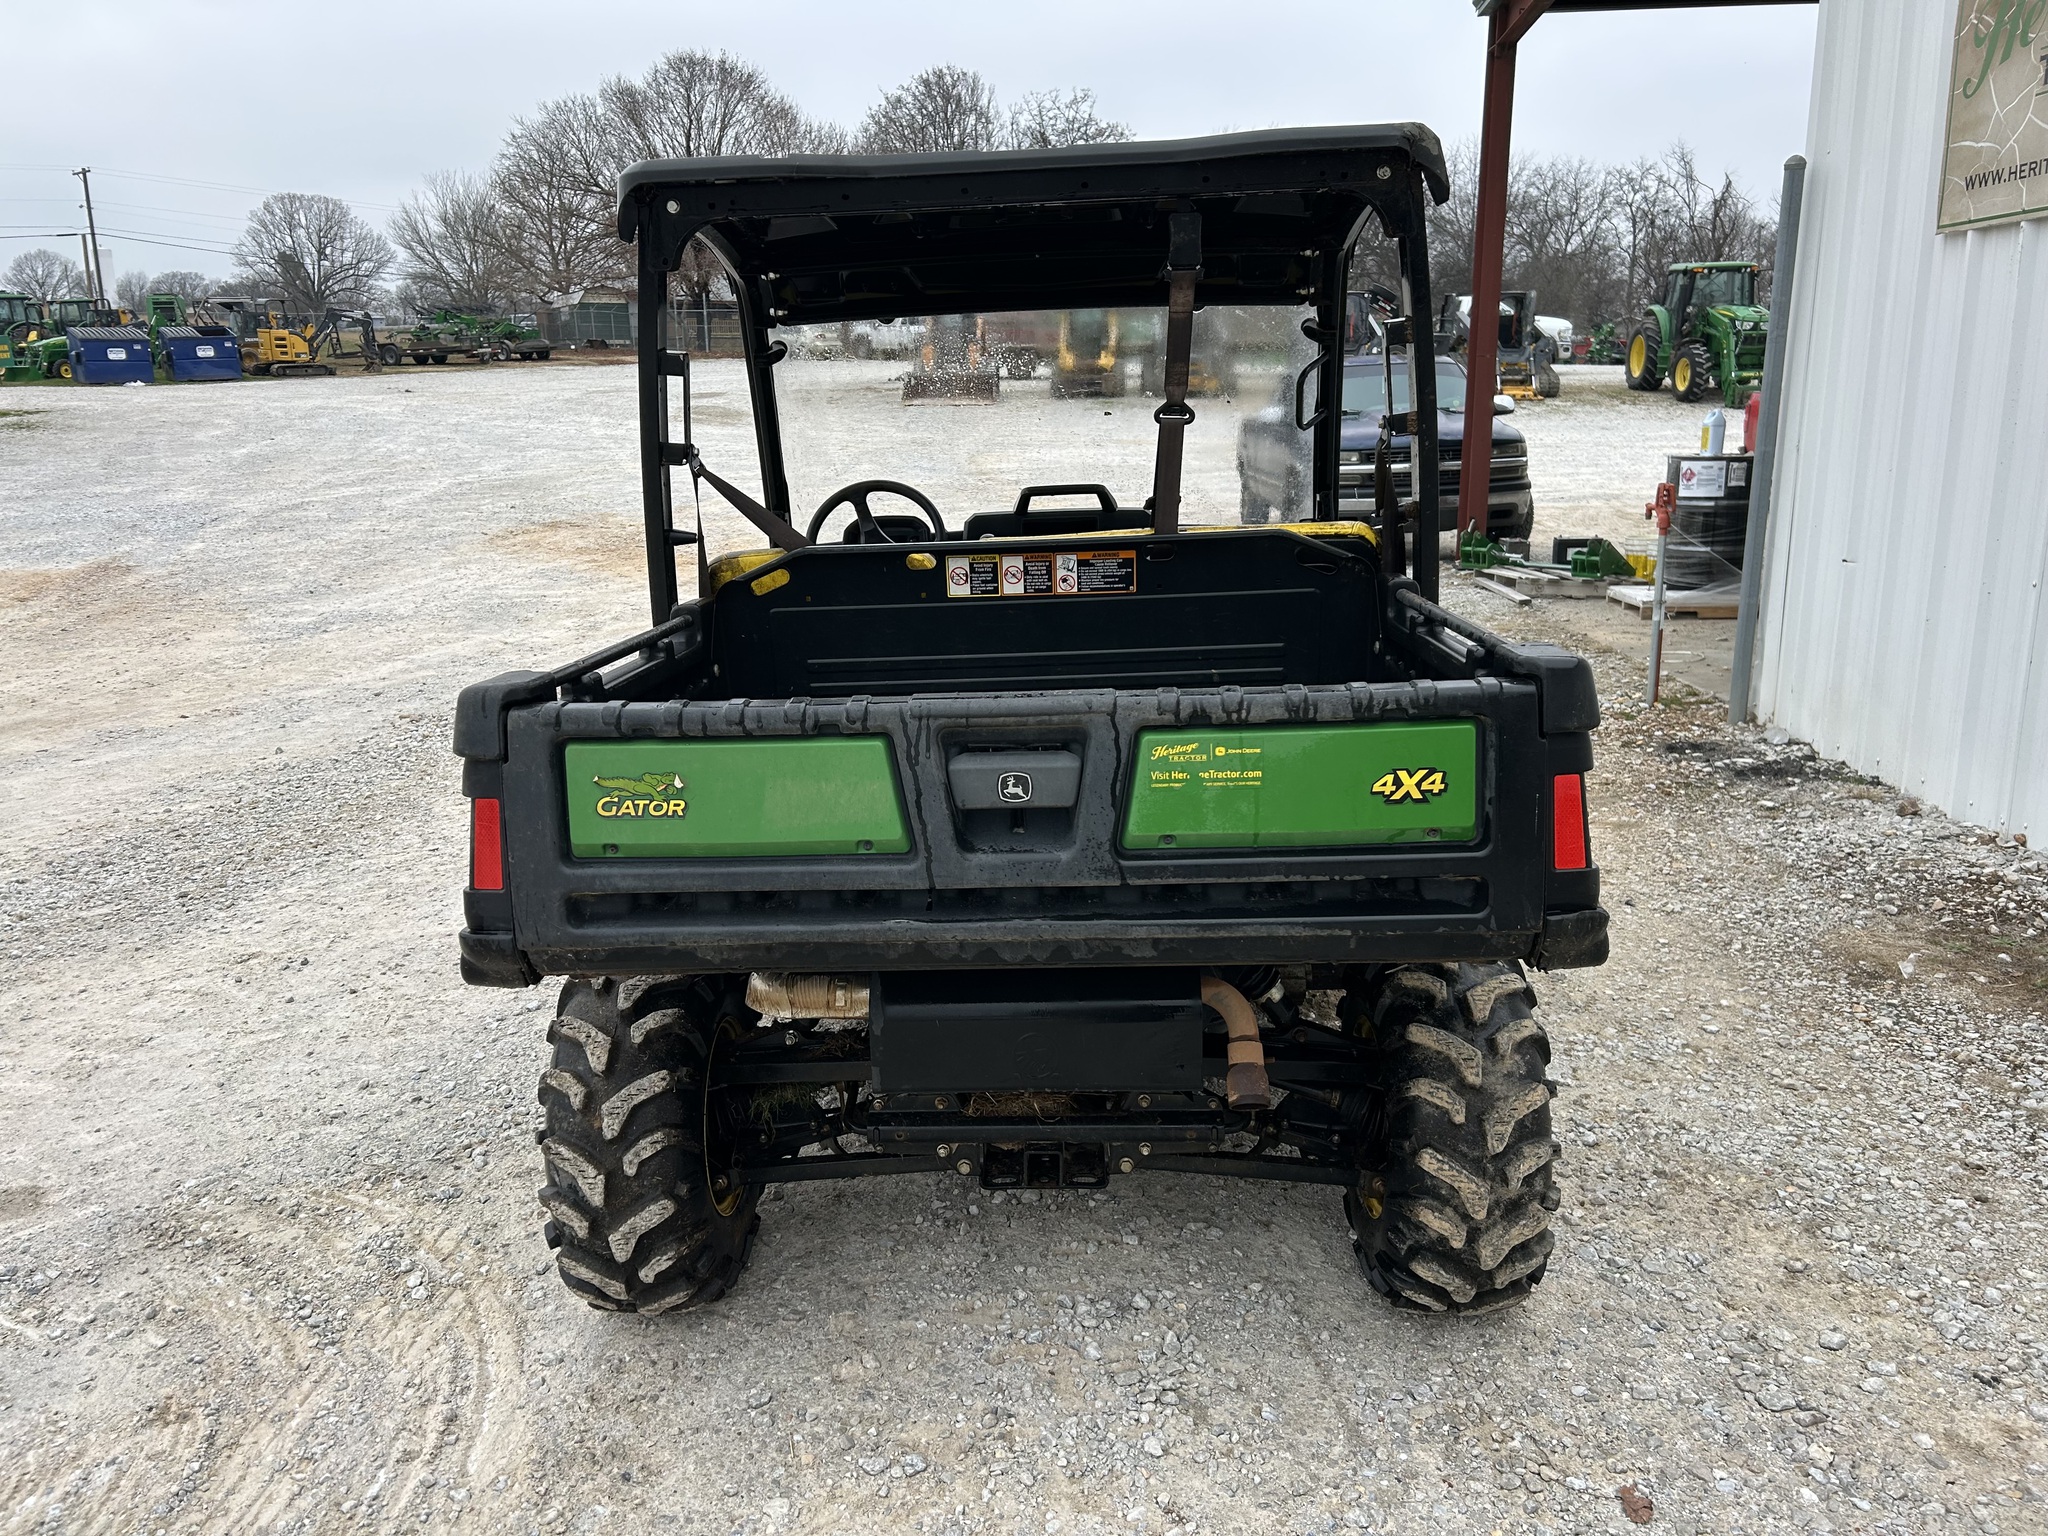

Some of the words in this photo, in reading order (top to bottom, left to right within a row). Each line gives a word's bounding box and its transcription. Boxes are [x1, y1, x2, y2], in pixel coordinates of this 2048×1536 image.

[1151, 742, 1199, 760] Heritage
[1150, 771, 1170, 780] Visit
[1171, 770, 1262, 780] HereTractor.com
[1371, 768, 1448, 803] 4X4
[596, 796, 686, 817] GATOR
